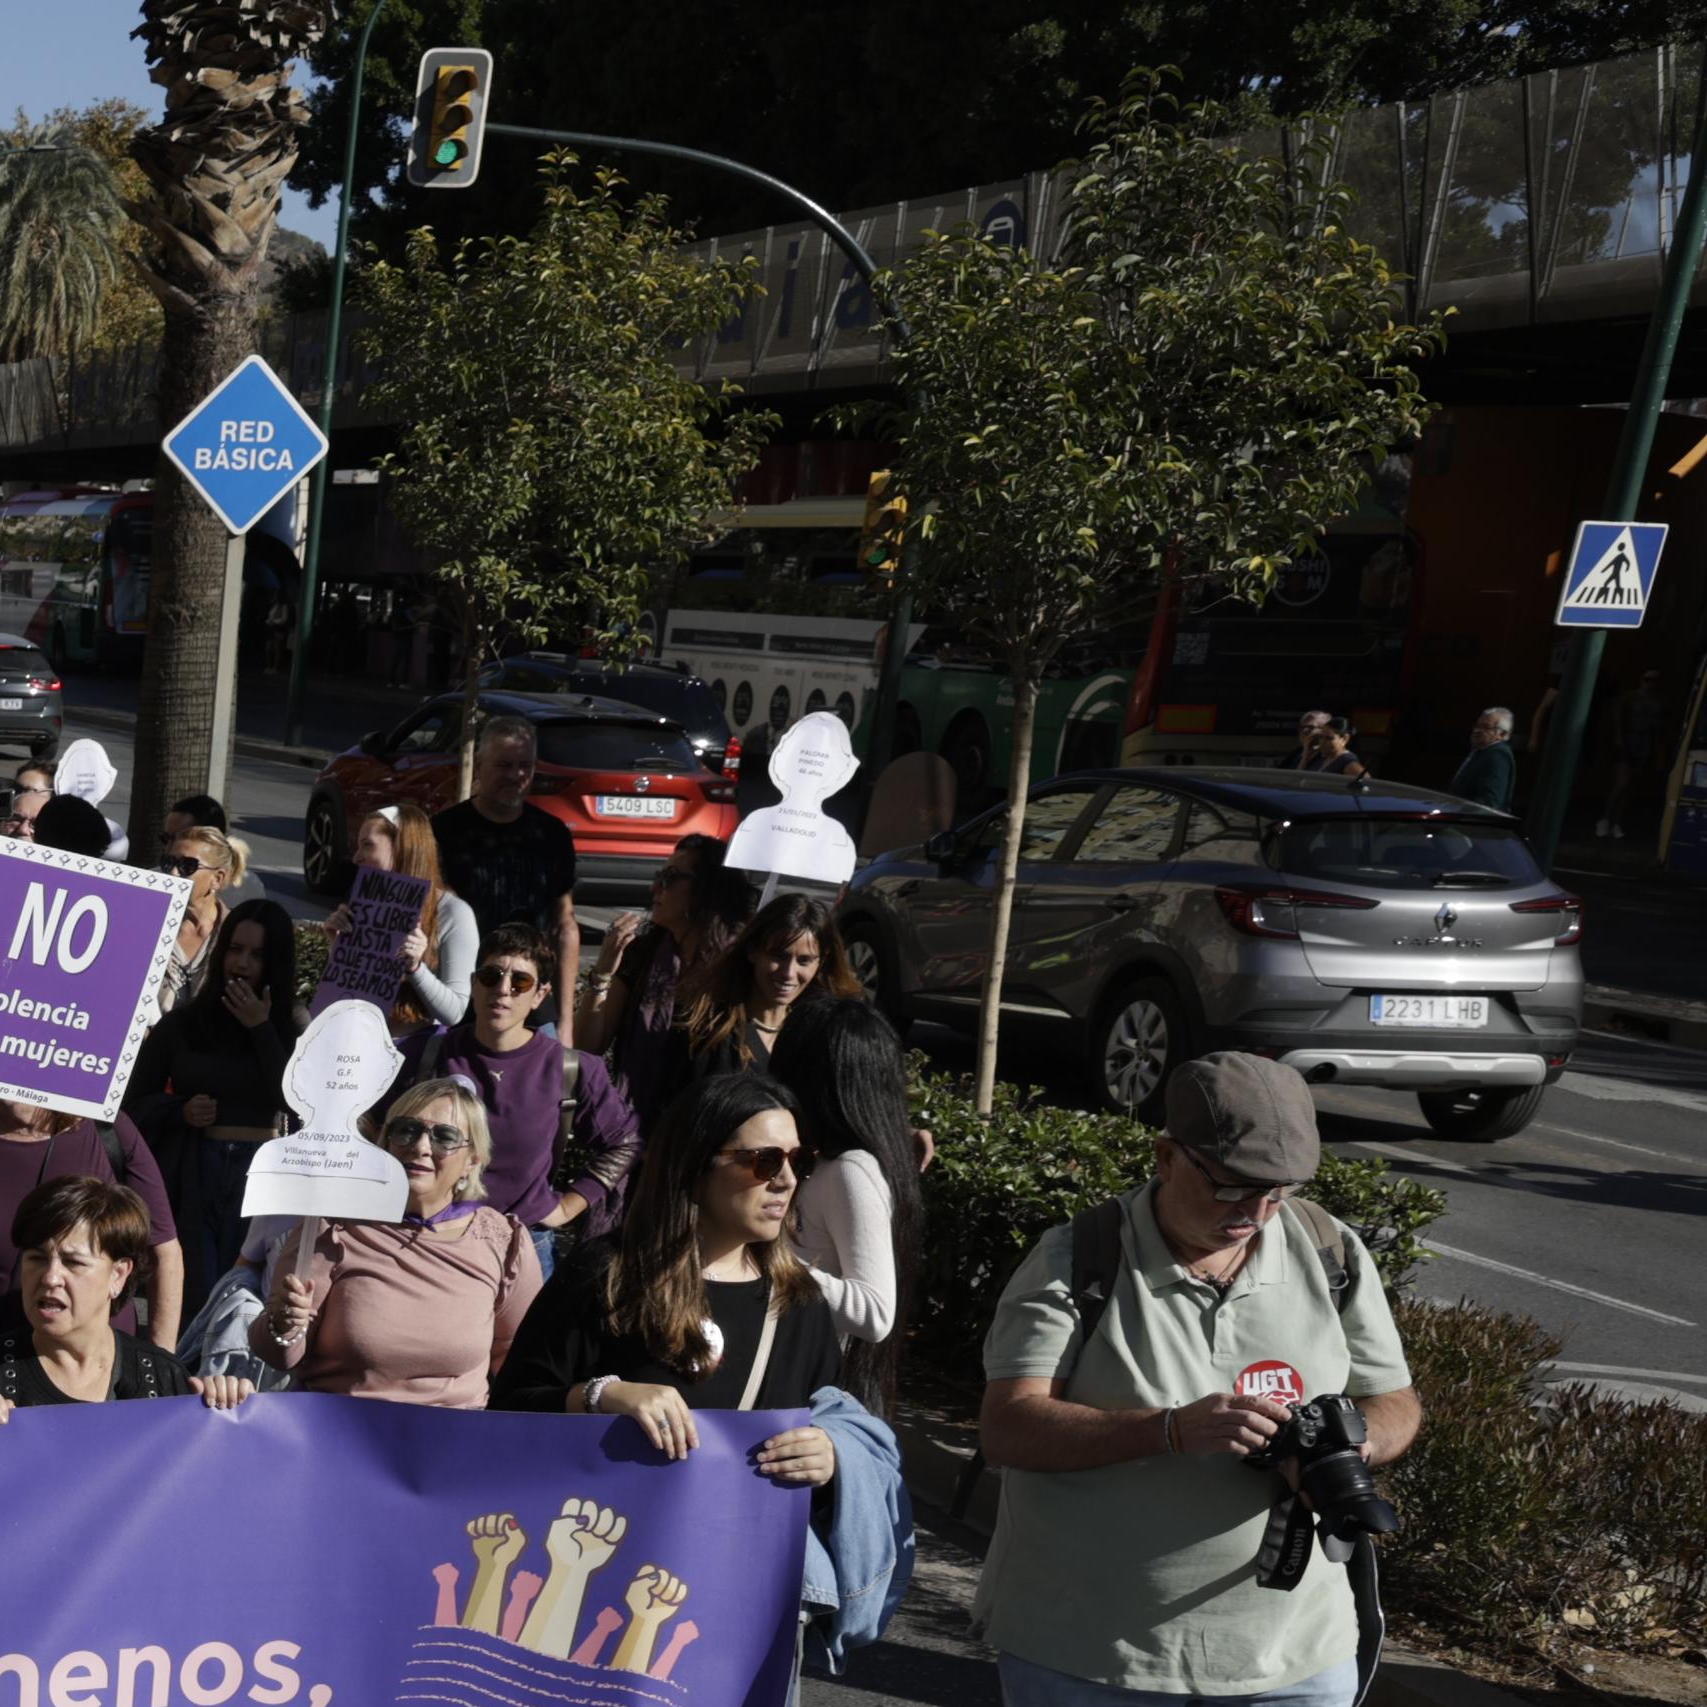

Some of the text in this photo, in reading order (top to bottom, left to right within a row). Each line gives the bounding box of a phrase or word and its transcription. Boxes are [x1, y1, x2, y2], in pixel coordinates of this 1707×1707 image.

[220, 421, 275, 443] RED
[194, 443, 294, 471] BÁSICA
[800, 750, 829, 759] PALOMA
[606, 800, 673, 814] 5409 LSC
[771, 825, 817, 838] VALLADOLID
[358, 872, 426, 908] NINGUNA
[7, 881, 109, 975] NO
[373, 906, 415, 933] LIBRE
[1393, 936, 1484, 949] CAPTUR
[333, 948, 364, 968] QUE
[338, 967, 397, 999] SEAMOS
[1384, 999, 1483, 1021] 2231 LHB
[0, 1029, 111, 1076] mujeres
[337, 1055, 361, 1063] ROSA
[337, 1069, 354, 1077] G.F.
[326, 1081, 358, 1090] 52 años
[16, 1087, 49, 1104] Málaga
[298, 1132, 350, 1143] 05/09/2023
[284, 1145, 359, 1158] Villanueva del
[281, 1157, 354, 1170] Arzobispo (Jaen)
[1242, 1368, 1296, 1395] UGT
[1282, 1527, 1307, 1576] Canon
